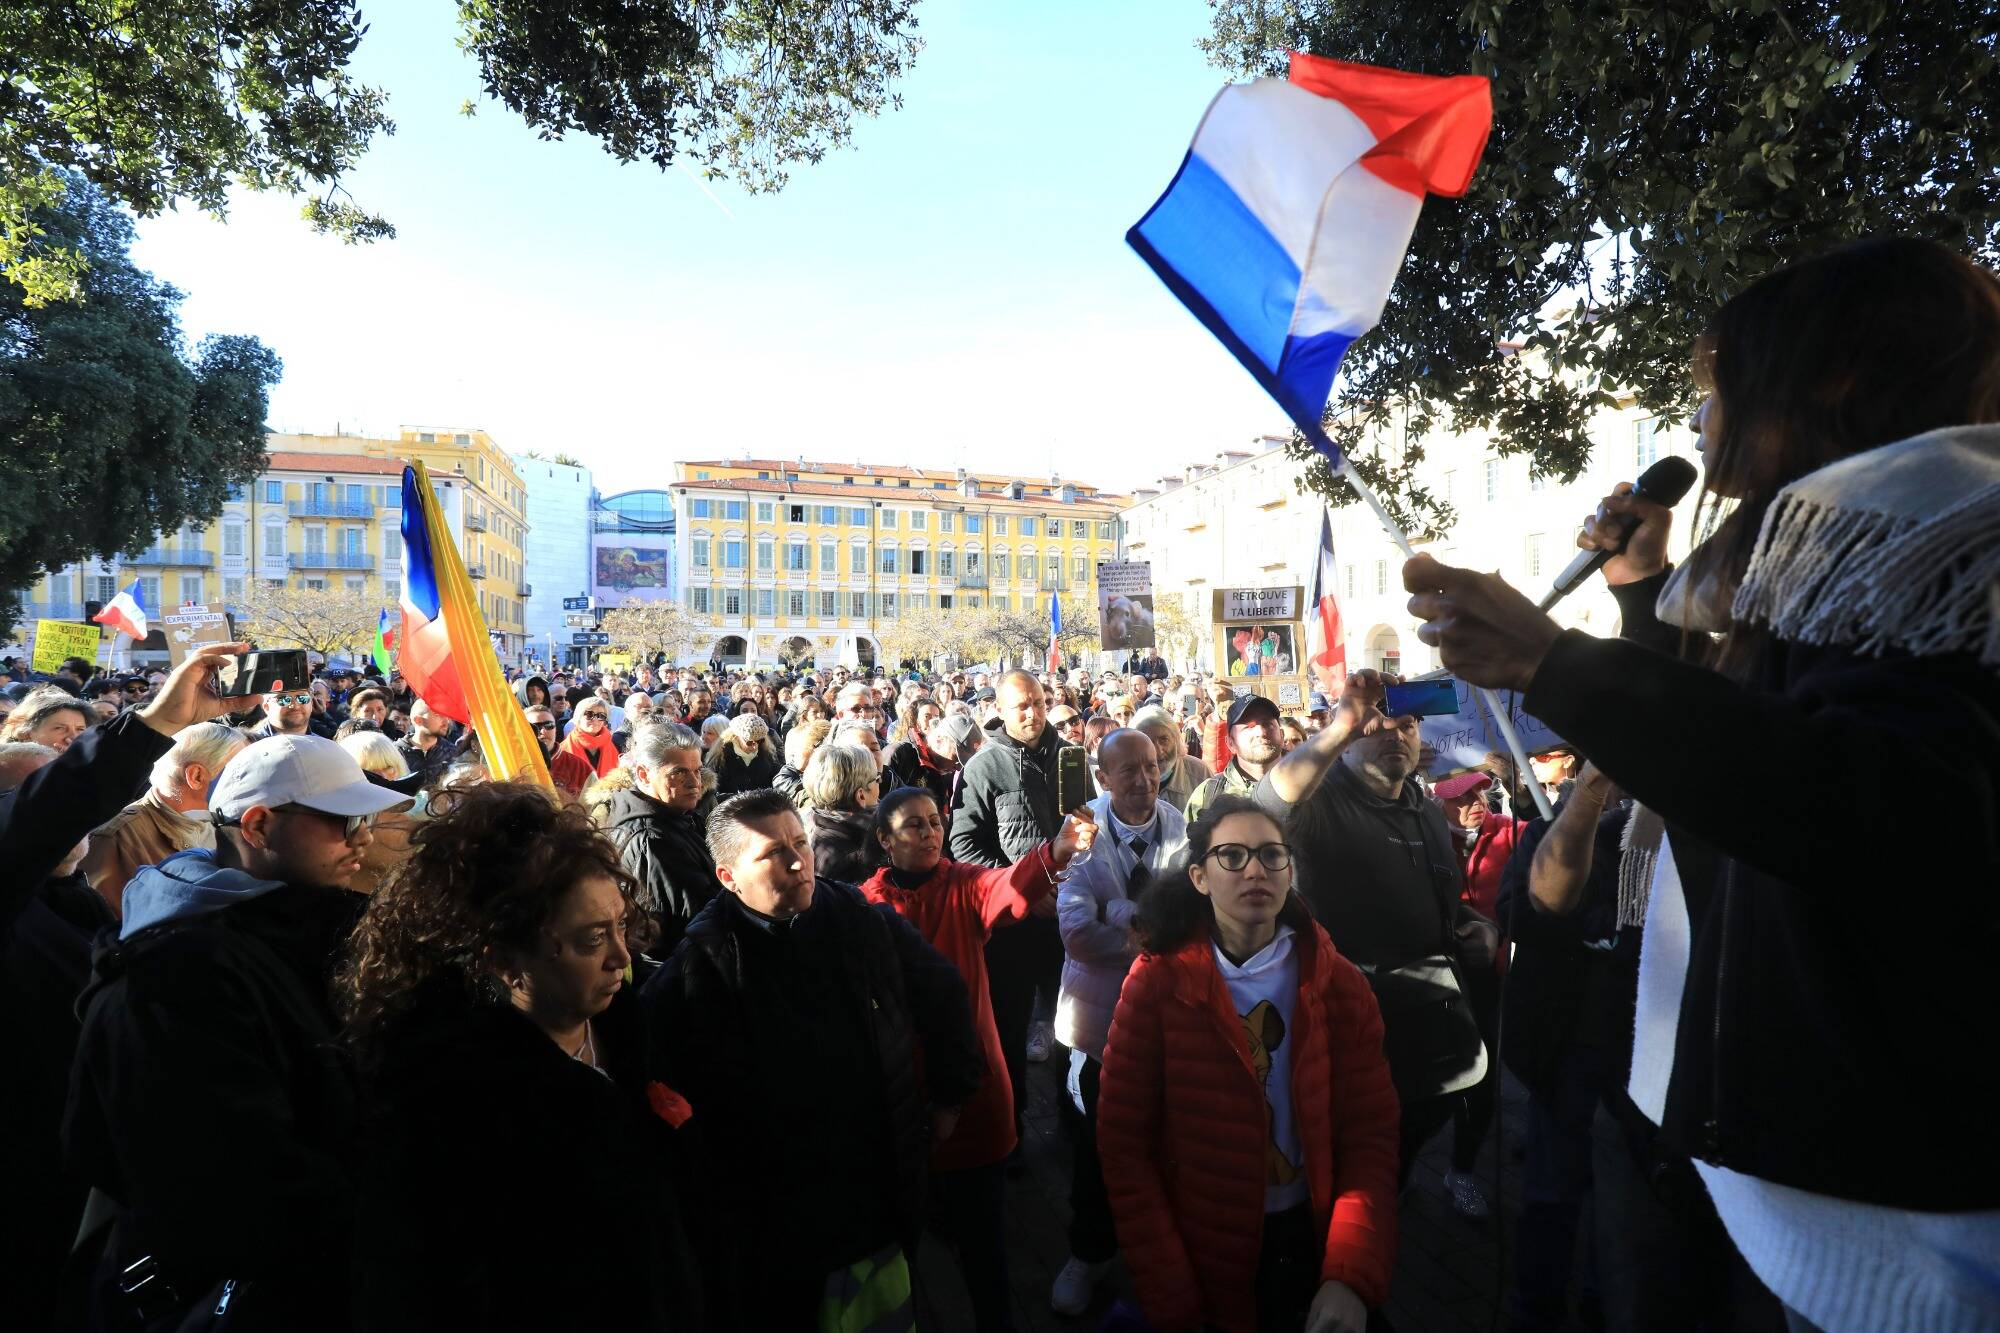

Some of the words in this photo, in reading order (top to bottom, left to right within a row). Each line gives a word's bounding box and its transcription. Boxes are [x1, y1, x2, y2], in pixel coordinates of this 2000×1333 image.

[1232, 590, 1288, 601] RETROUVE
[1231, 608, 1244, 617] TA
[1247, 606, 1288, 616] LIBERTE
[166, 614, 223, 624] EXPERIMENTAL
[69, 635, 91, 646] TYRAN
[1279, 703, 1306, 717] Signal
[1430, 727, 1474, 755] NOTRE
